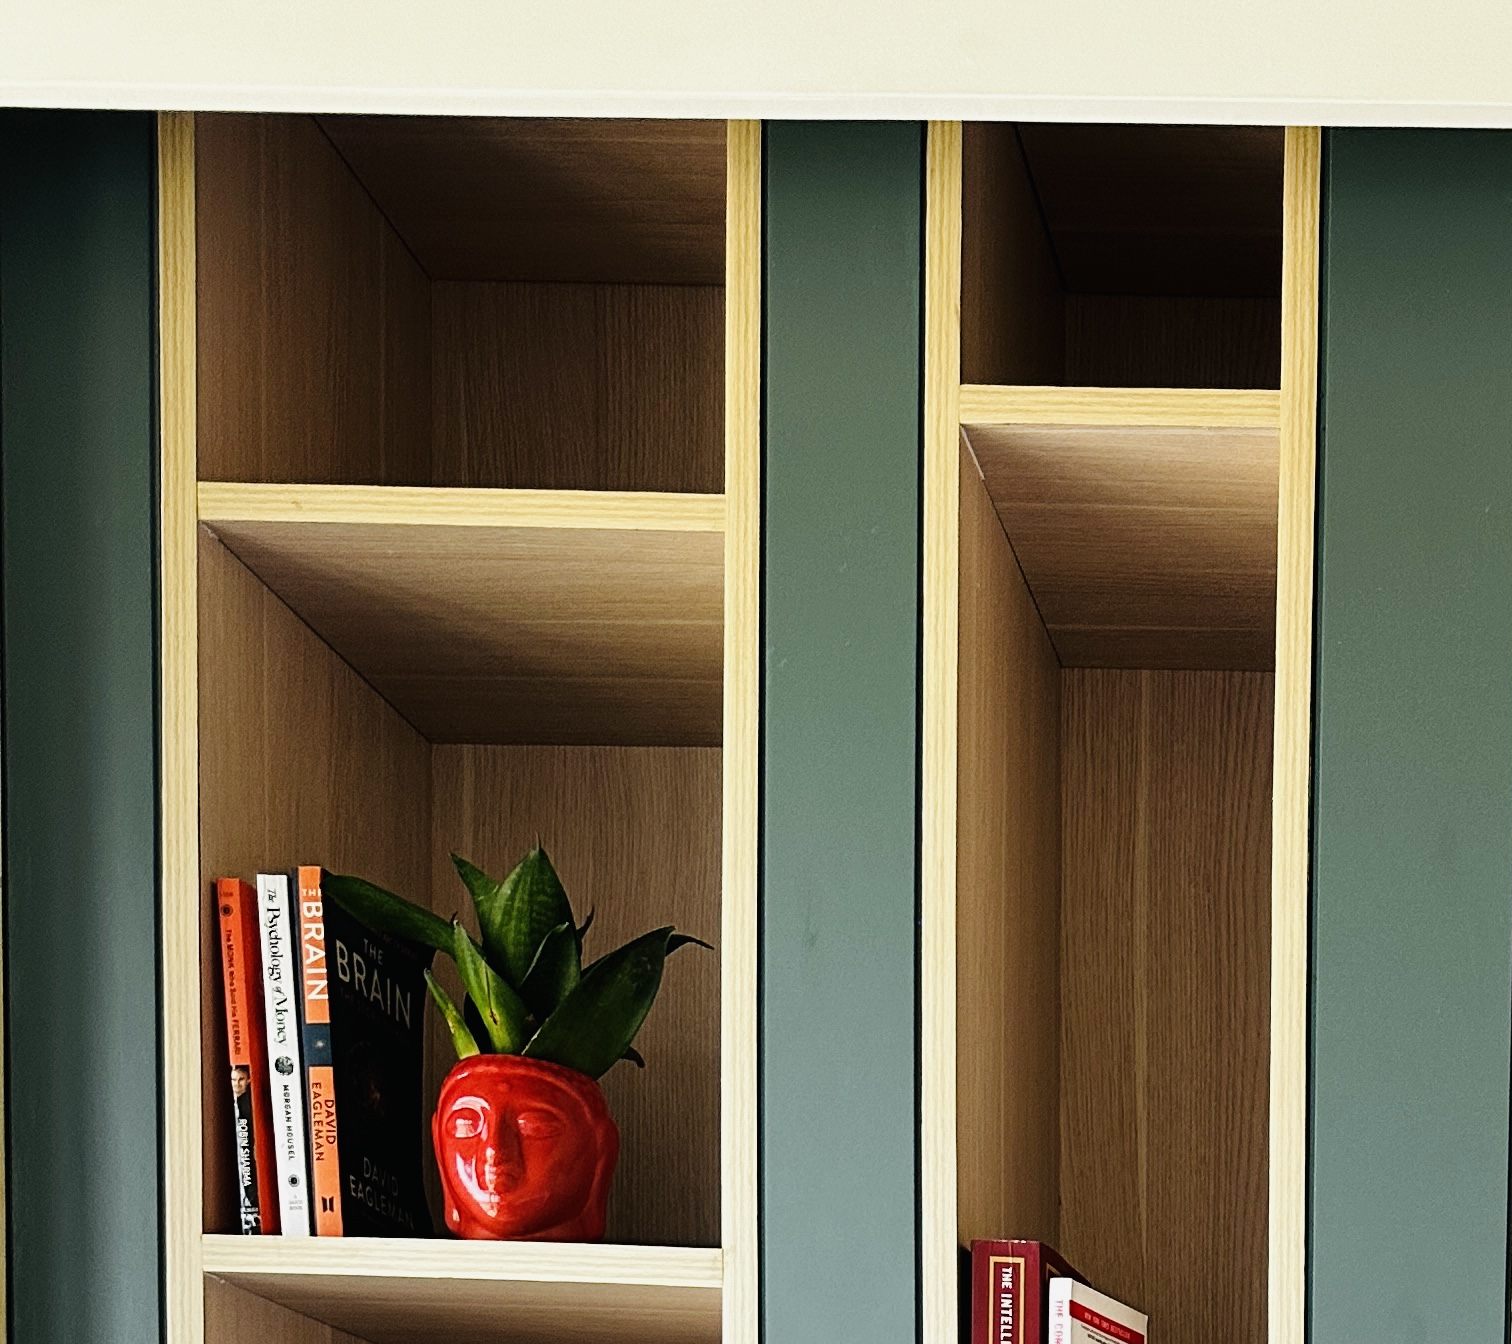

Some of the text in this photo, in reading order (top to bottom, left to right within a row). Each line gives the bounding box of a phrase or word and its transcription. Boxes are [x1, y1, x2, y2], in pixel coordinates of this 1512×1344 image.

[265, 907, 284, 983] Psychology
[303, 901, 330, 1000] BRAIN
[363, 937, 384, 966] THE
[335, 938, 412, 1030] BRAIN
[274, 997, 288, 1047] Money
[282, 1084, 296, 1161] MORGAN HOUSEL
[311, 1082, 325, 1162] EAGLEMAN
[324, 1099, 337, 1145] DAVID
[239, 1148, 252, 1187] SHARMA
[362, 1156, 399, 1197] DAVID
[349, 1174, 415, 1231] EAGLEMAN
[1001, 1266, 1013, 1289] THE
[1054, 1300, 1064, 1318] THE
